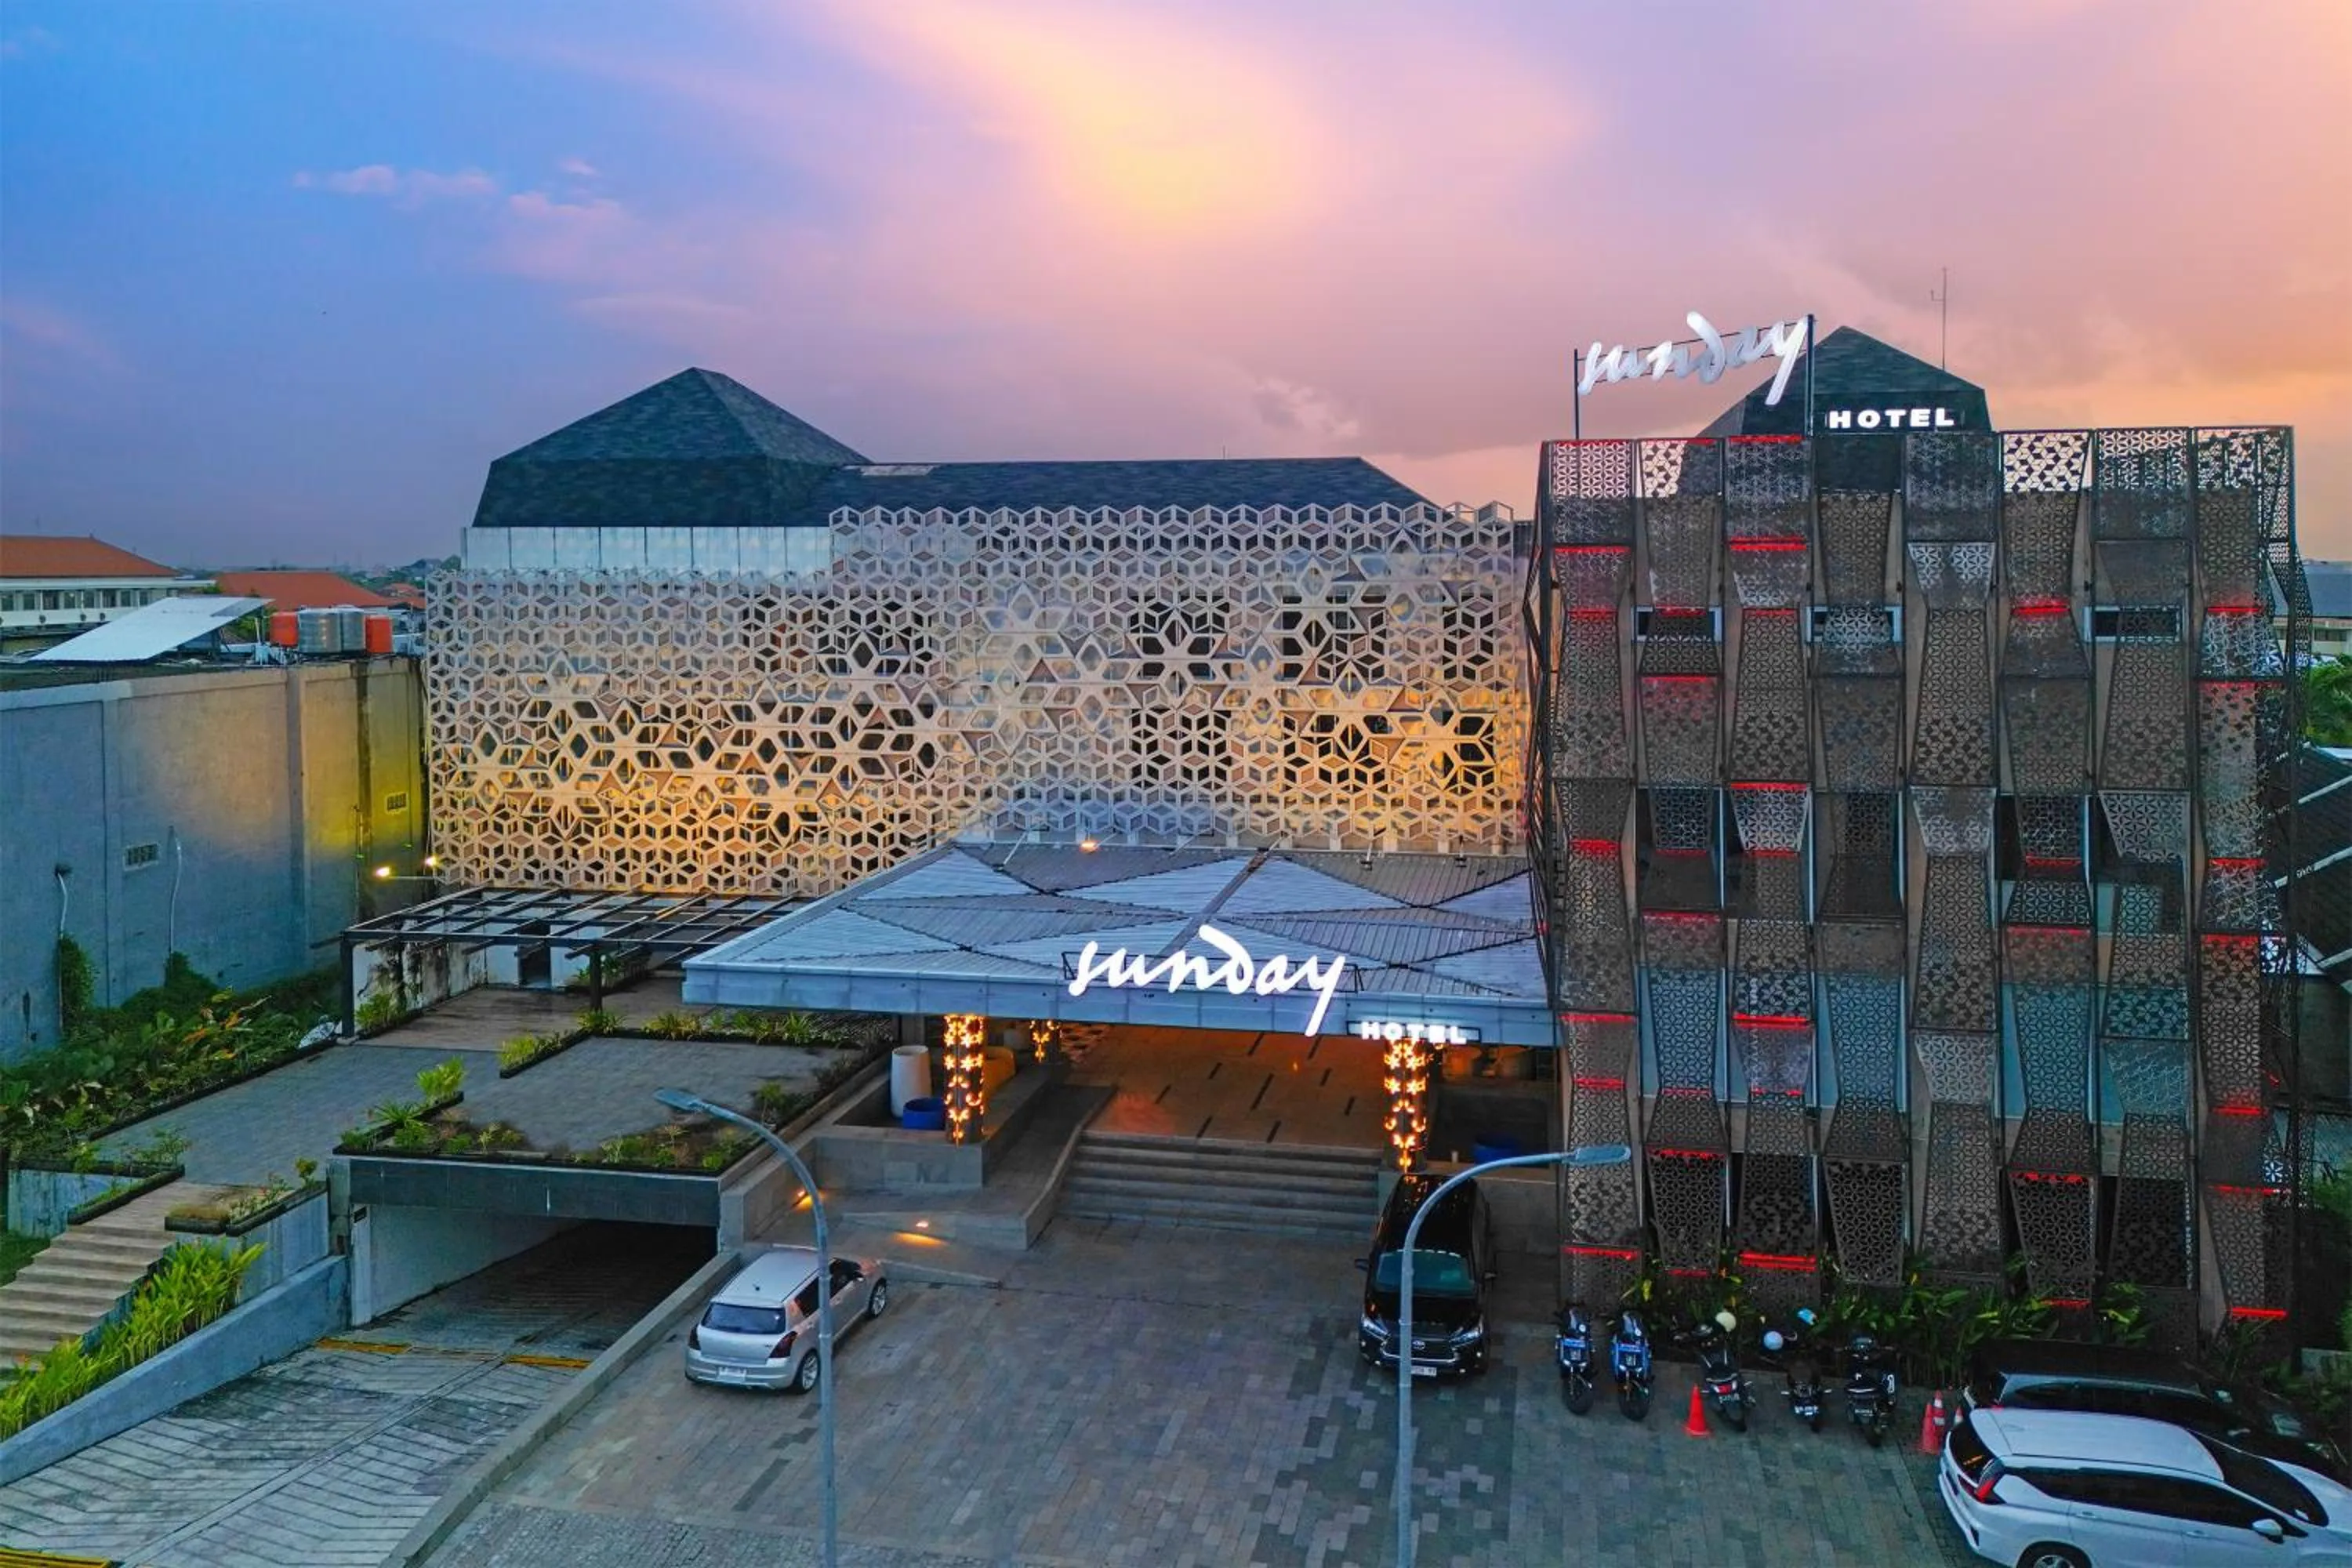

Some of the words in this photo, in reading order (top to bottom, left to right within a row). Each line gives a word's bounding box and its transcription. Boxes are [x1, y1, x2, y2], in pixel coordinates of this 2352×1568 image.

[1577, 311, 1809, 405] sunday
[1828, 408, 1955, 430] HOTEL
[1068, 924, 1346, 1037] sunday
[1361, 1022, 1467, 1045] HOTEL
